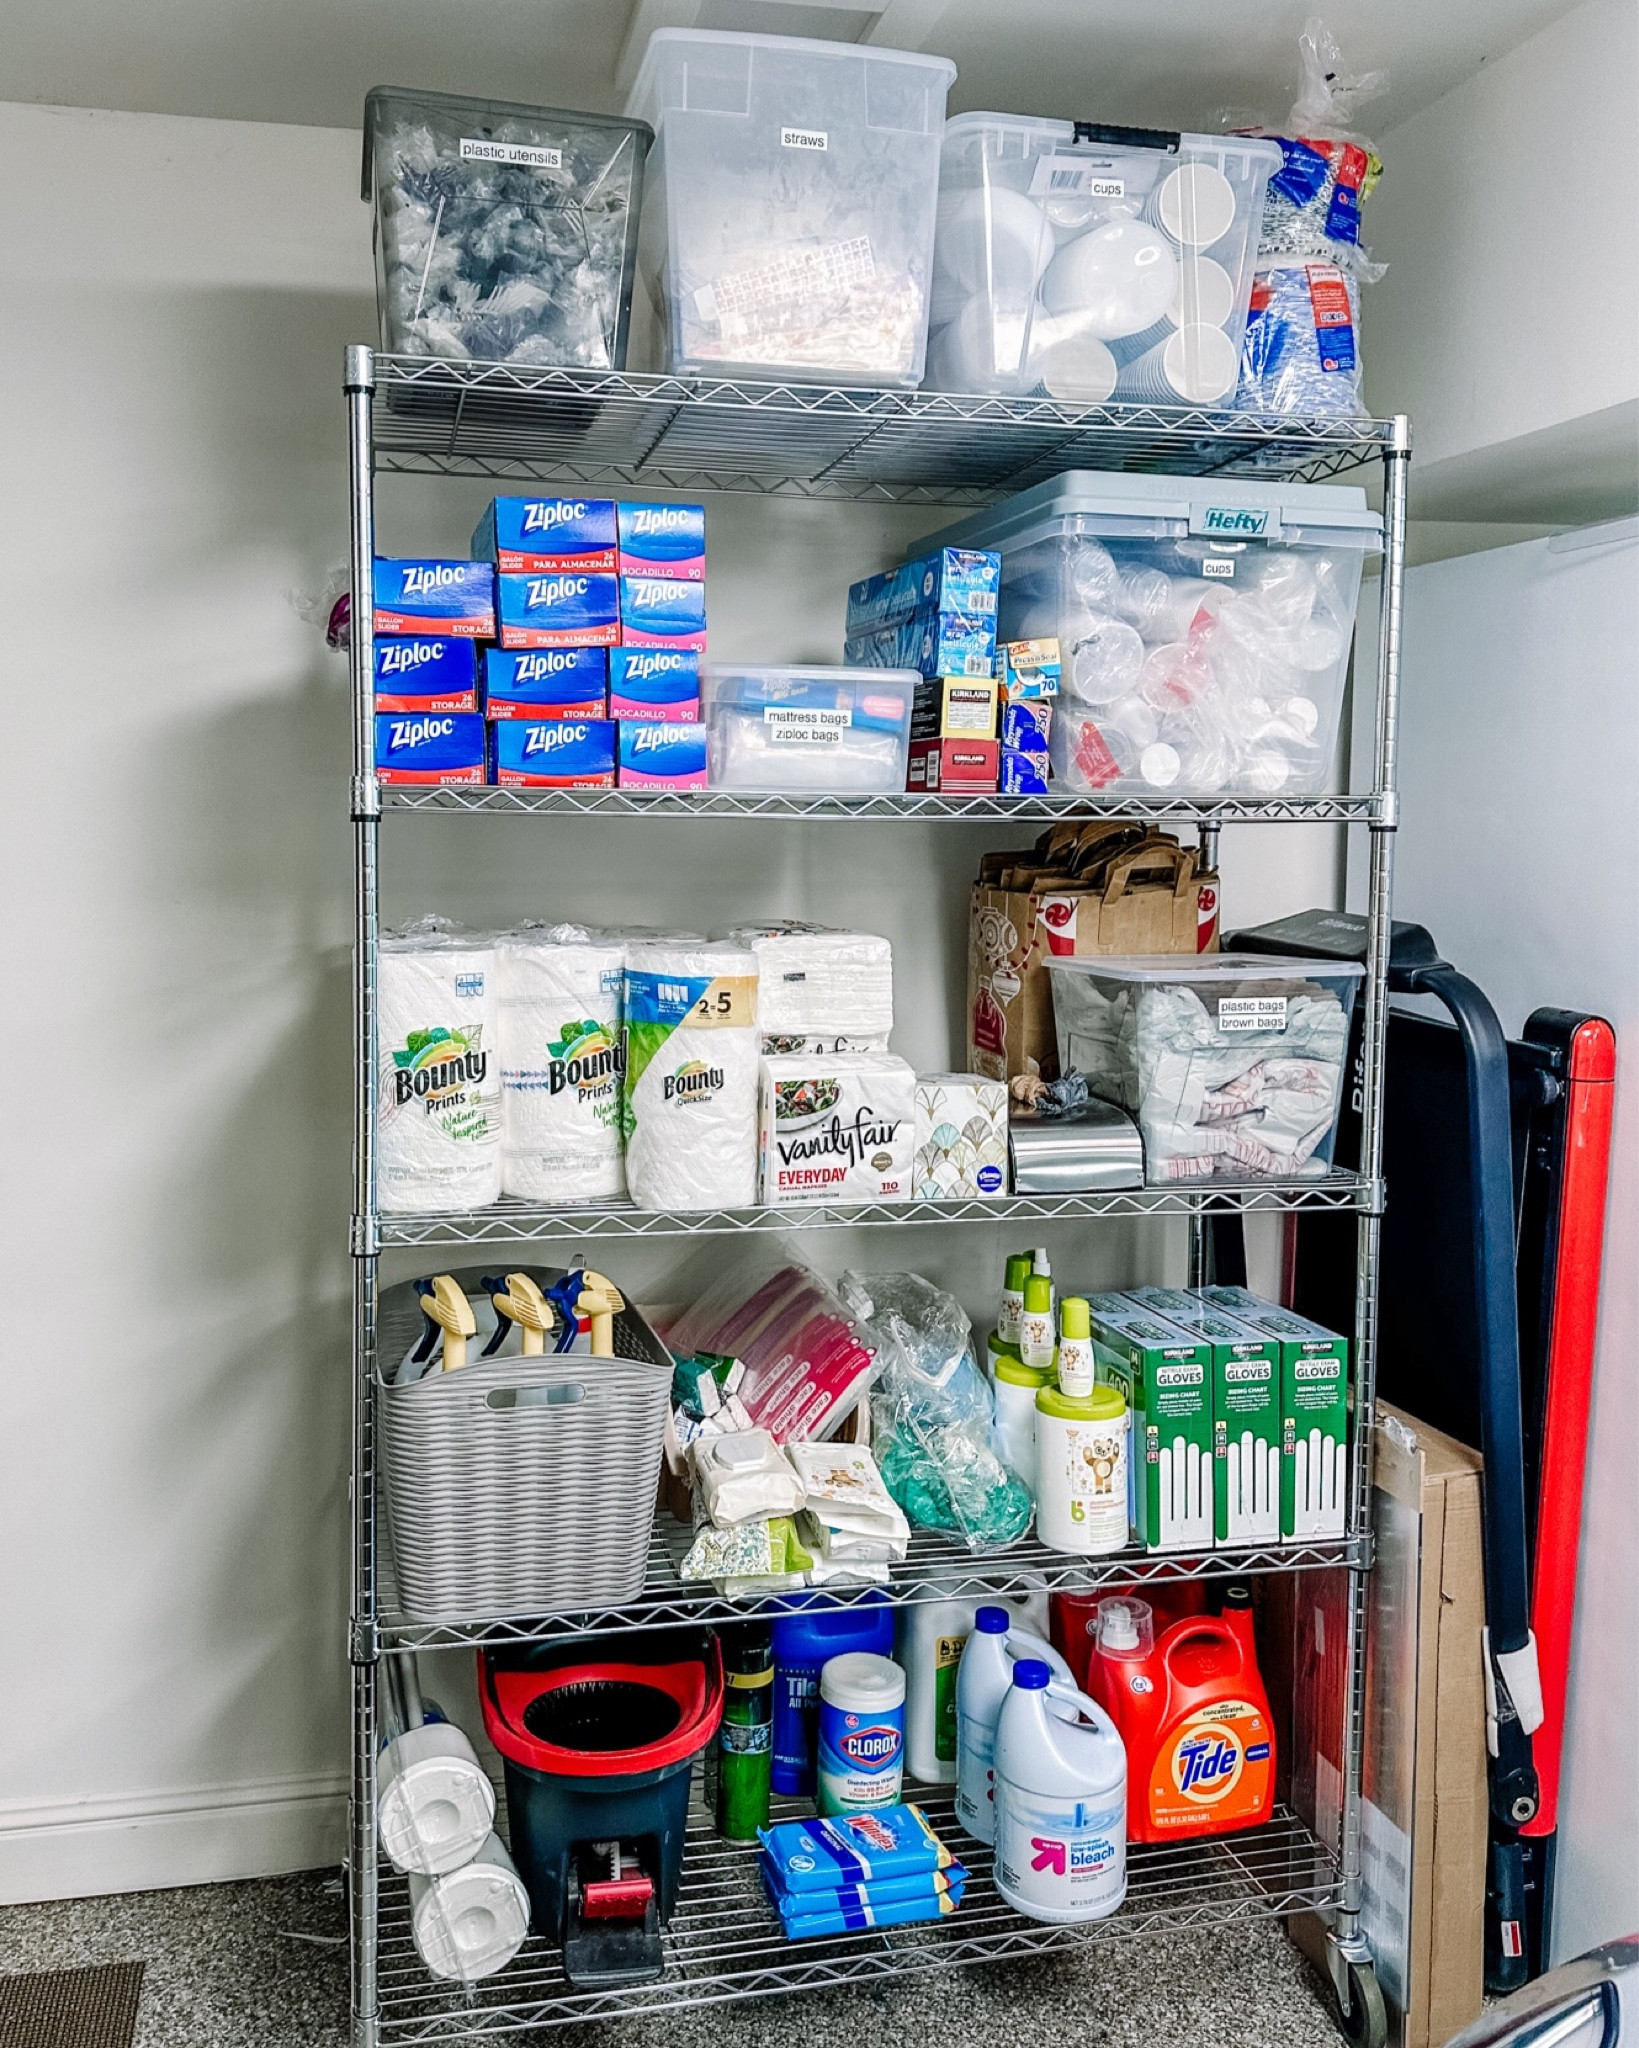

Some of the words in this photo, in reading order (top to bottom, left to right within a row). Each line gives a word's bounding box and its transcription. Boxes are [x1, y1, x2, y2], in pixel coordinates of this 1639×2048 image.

[784, 131, 825, 148] straws
[463, 143, 505, 160] plastic
[509, 148, 559, 165] utensils
[1093, 184, 1122, 196] cups
[524, 501, 586, 531] Ziploc
[633, 508, 689, 534] Ziploc
[1207, 511, 1264, 534] Hefty
[533, 561, 558, 569] PARA
[560, 560, 615, 569] ALMACENAR
[604, 552, 614, 560] 26
[621, 567, 674, 577] BOCADILLO
[688, 568, 701, 578] 90
[1205, 563, 1232, 575] cups
[402, 564, 465, 594] Ziploc
[527, 576, 588, 606] Ziploc
[634, 581, 688, 609] Ziploc
[452, 624, 495, 634] STORAGE
[606, 627, 617, 635] 26
[536, 636, 561, 644] PARA
[564, 634, 617, 644] ALMACENAR
[380, 642, 444, 674] Ziploc
[515, 651, 577, 681] Ziploc
[626, 652, 681, 679] Ziploc
[951, 690, 989, 698] KIRKLAND
[1041, 680, 1056, 691] 70
[431, 701, 473, 710] STORAGE
[462, 693, 473, 701] 26
[563, 710, 603, 718] STORAGE
[613, 709, 666, 718] BOCADILLO
[681, 710, 694, 720] 90
[768, 711, 818, 723] mattress
[820, 712, 849, 726] bags
[1036, 708, 1048, 734] 250
[390, 717, 454, 749] Ziploc
[525, 723, 586, 754] Ziploc
[634, 725, 690, 752] Ziploc
[775, 728, 809, 741] ziploc
[811, 729, 839, 742] bags
[471, 769, 482, 777] 26
[1035, 754, 1046, 780] 250
[440, 776, 482, 785] STORAGE
[1221, 1001, 1256, 1012] plastic
[1258, 1000, 1285, 1013] bags
[1221, 1018, 1254, 1028] brown
[1257, 1017, 1284, 1028] bags
[394, 1050, 487, 1106] Bounty
[663, 1067, 724, 1100] Bounty
[578, 1082, 613, 1104] Prints
[425, 1091, 466, 1115] Prints
[778, 1167, 848, 1185] EVERYDAY
[881, 1181, 899, 1190] 110
[1158, 1372, 1202, 1385] GLOVES
[1227, 1368, 1270, 1380] GLOVES
[1296, 1366, 1339, 1378] GLOVES
[811, 1394, 829, 1414] Face
[774, 1403, 797, 1432] Shield
[785, 1677, 818, 1697] Tile
[788, 1697, 802, 1708] All
[848, 1733, 897, 1757] CLOROX
[1179, 1741, 1237, 1792] Tide
[845, 1814, 896, 1851] Windex
[1070, 1840, 1110, 1853] low-splash
[1070, 1845, 1115, 1866] bleach
